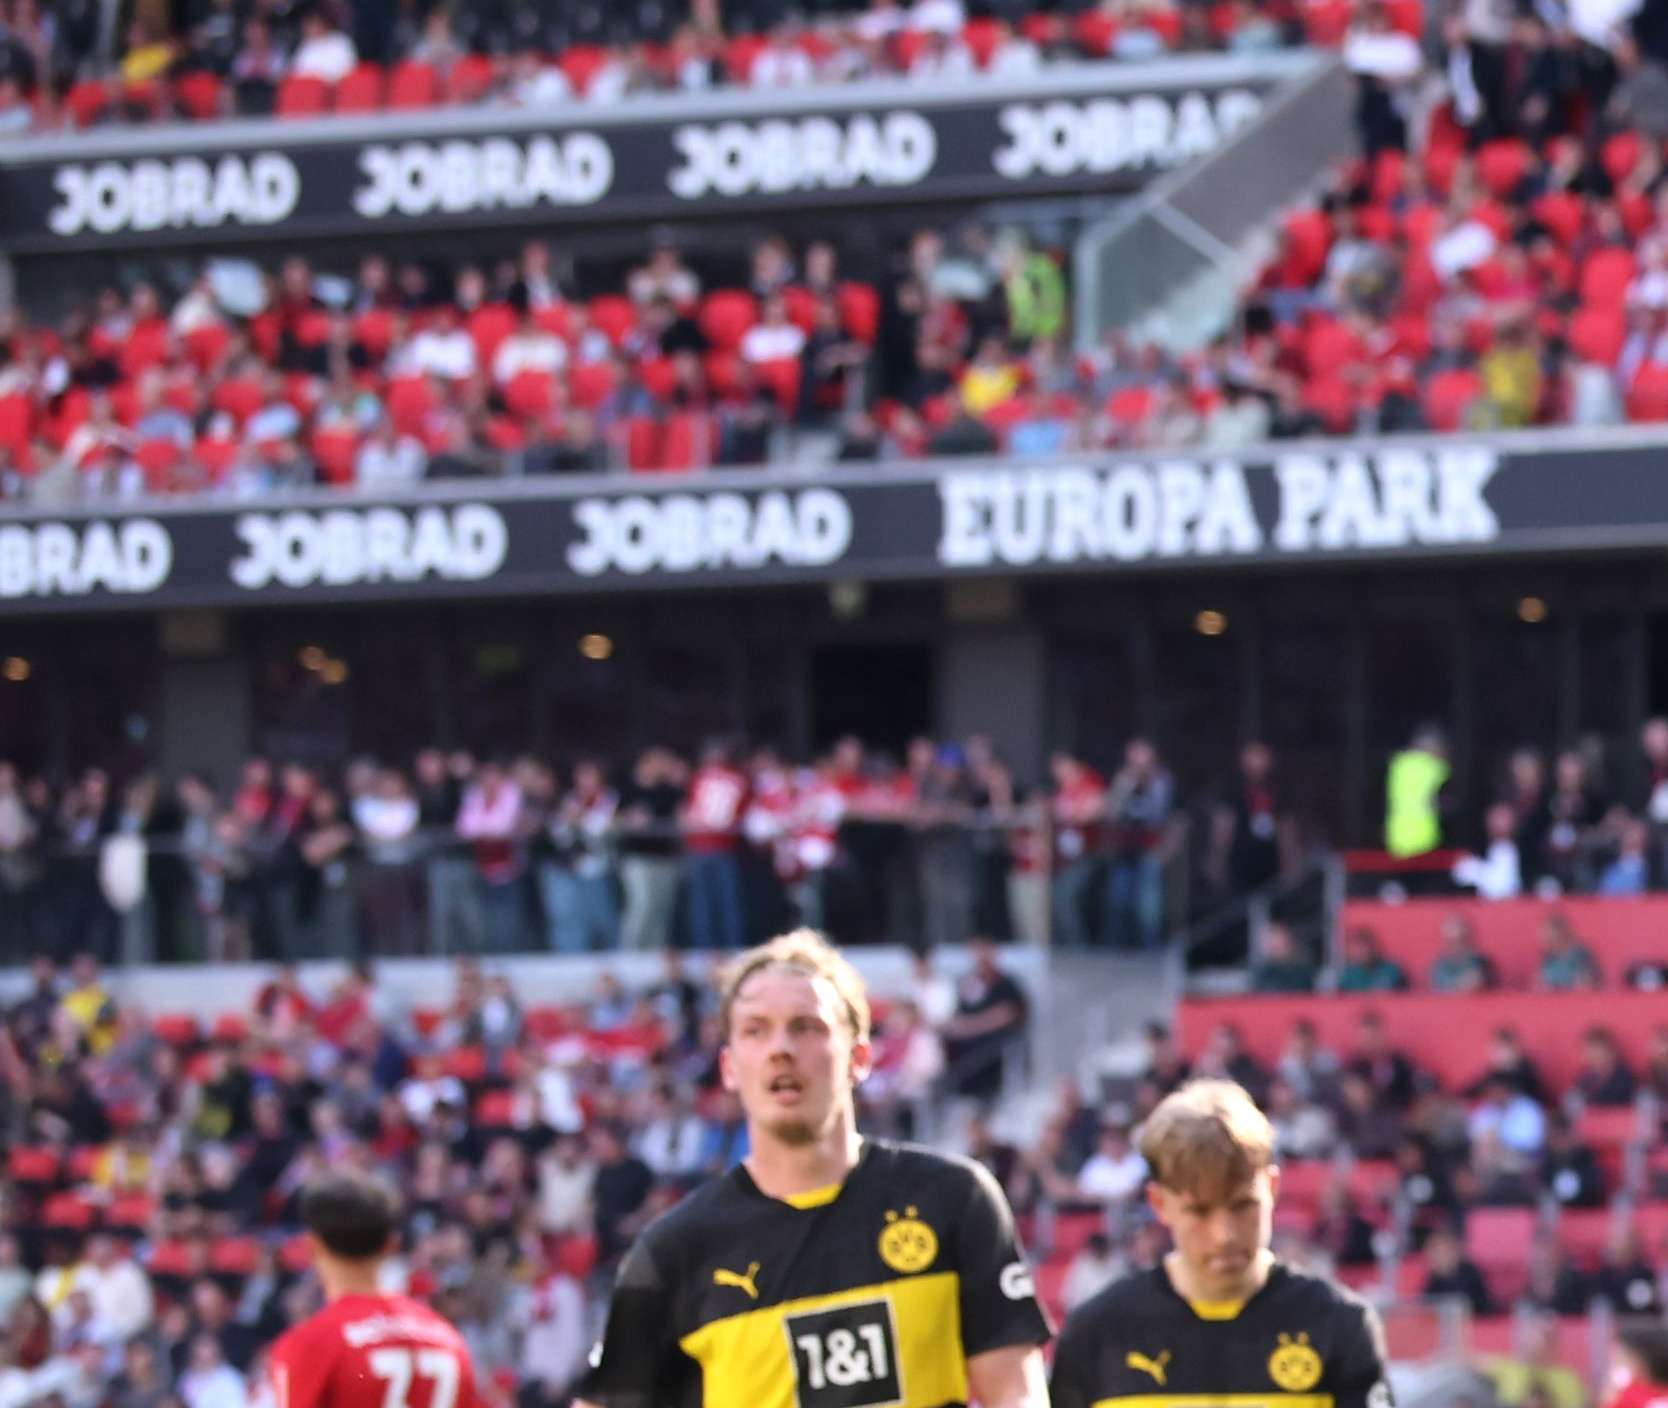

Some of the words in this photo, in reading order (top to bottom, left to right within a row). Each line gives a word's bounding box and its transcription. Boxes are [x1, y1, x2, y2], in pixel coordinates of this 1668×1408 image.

[49, 151, 300, 236] JOBRAD
[353, 131, 614, 219] JOBRAD
[668, 115, 936, 199] JOBRAD
[231, 503, 507, 589] JOBRAD
[567, 488, 851, 577] JOBRAD
[937, 461, 1263, 568] EUROPA
[1275, 449, 1502, 551] PARK
[797, 1323, 889, 1389] 1&1
